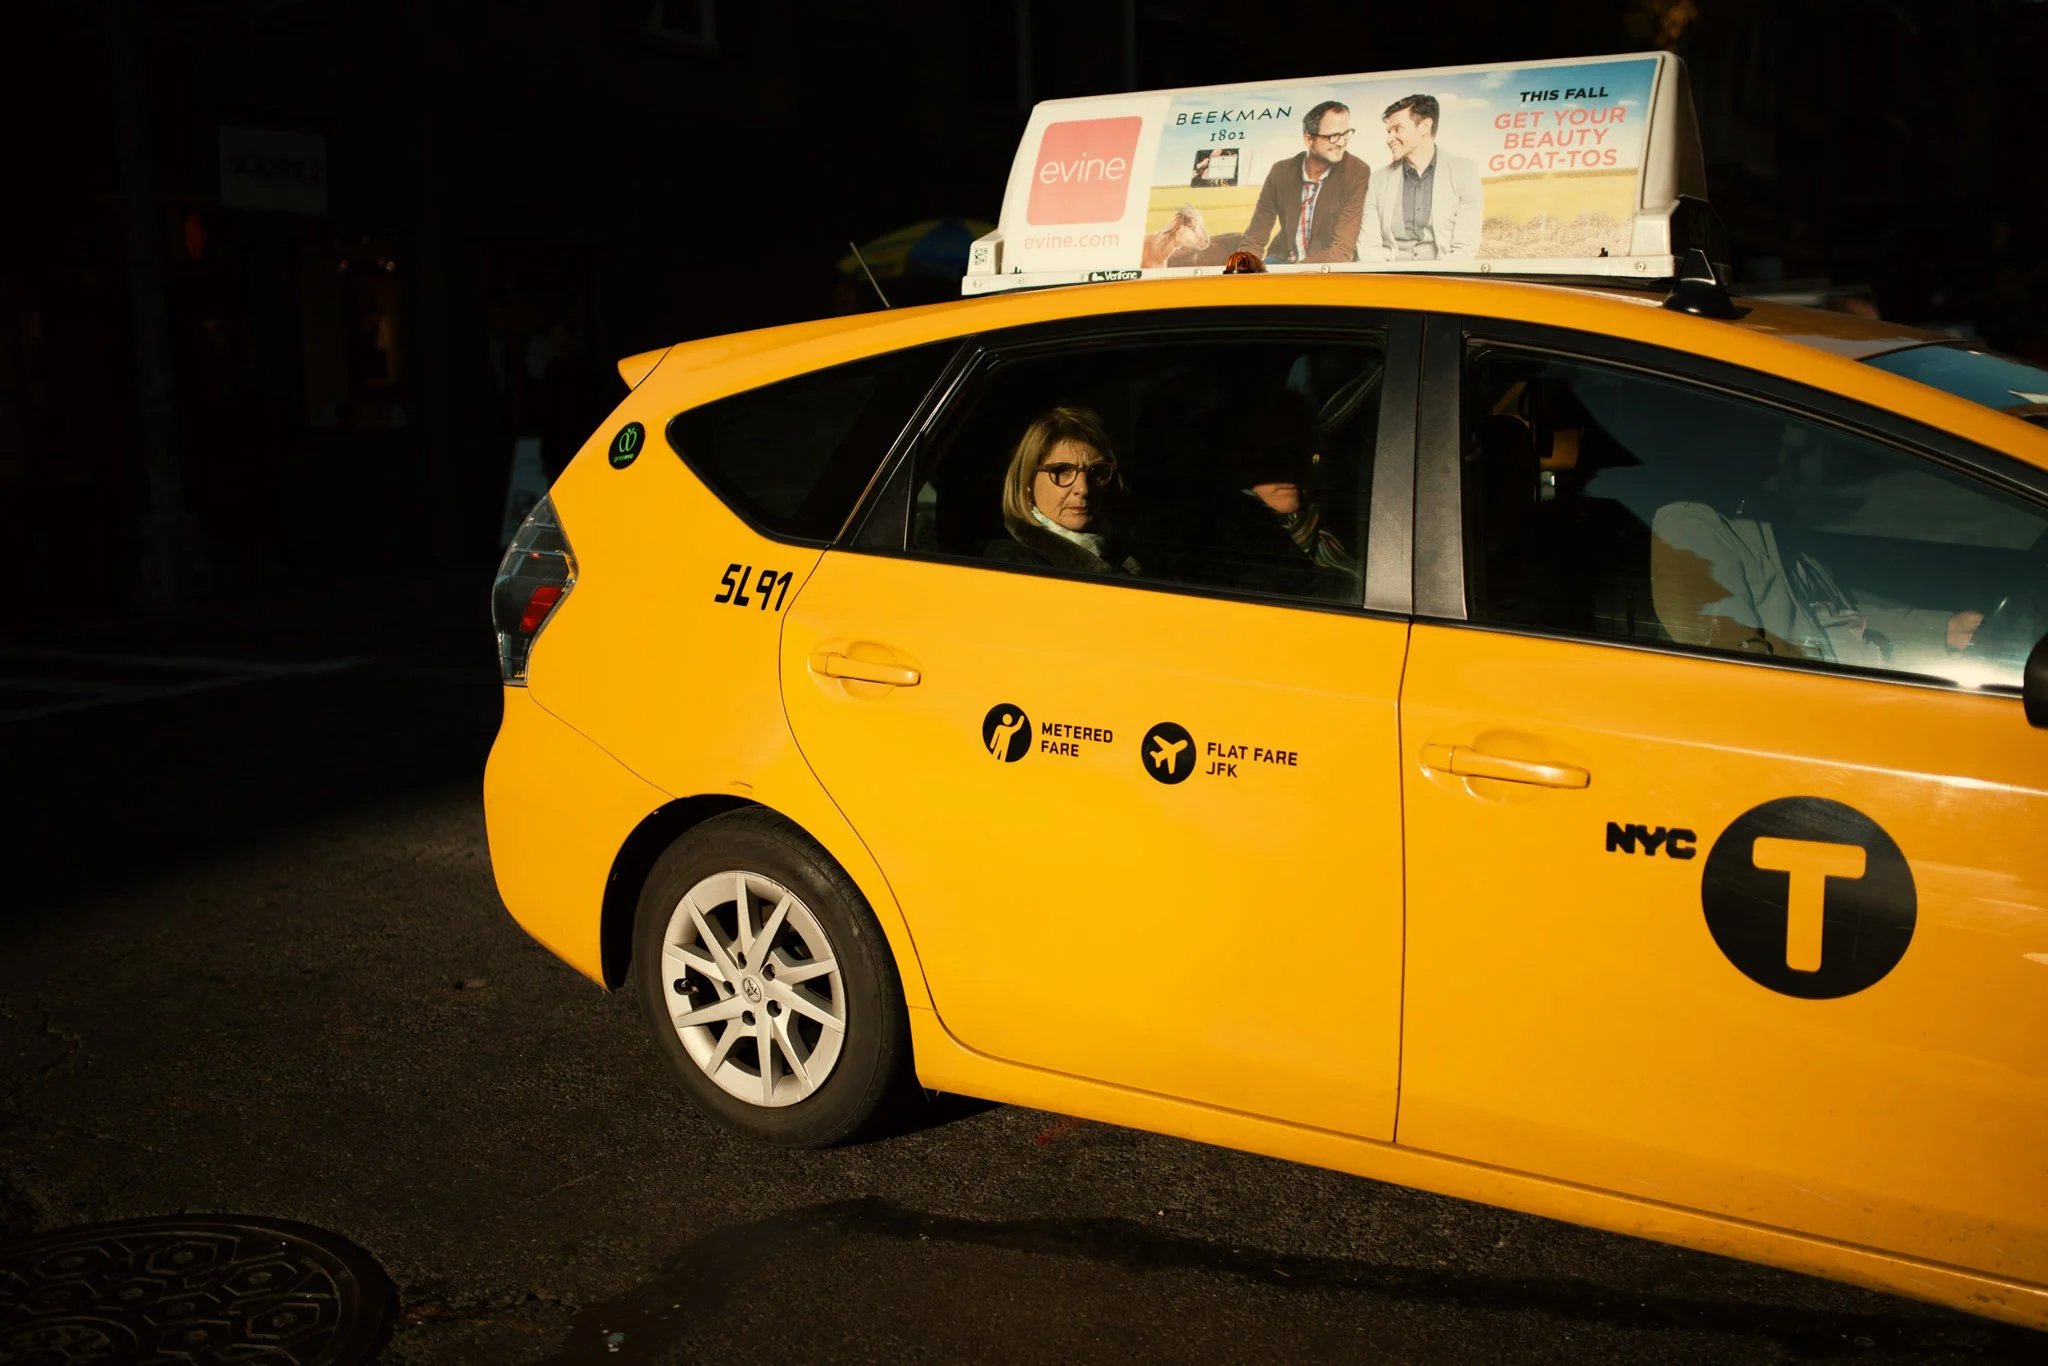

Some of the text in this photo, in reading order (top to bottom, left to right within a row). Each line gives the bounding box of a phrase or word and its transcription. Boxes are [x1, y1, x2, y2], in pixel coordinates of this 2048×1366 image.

[1520, 86, 1609, 102] THIS FALL
[1176, 106, 1292, 126] BEEKMAN
[1494, 107, 1626, 129] GET YOUR
[1209, 130, 1246, 142] 1802
[1504, 128, 1609, 149] BEAUTY
[1039, 152, 1126, 185] evine
[1488, 149, 1617, 171] GOAT-TOS
[1023, 232, 1120, 250] evine.com
[1040, 721, 1114, 744] METERED
[1040, 740, 1080, 758] FARE
[1206, 742, 1299, 767] FLAT FARE
[1205, 761, 1238, 779] JFK
[1606, 822, 1697, 860] NYC
[1752, 836, 1867, 972] T
